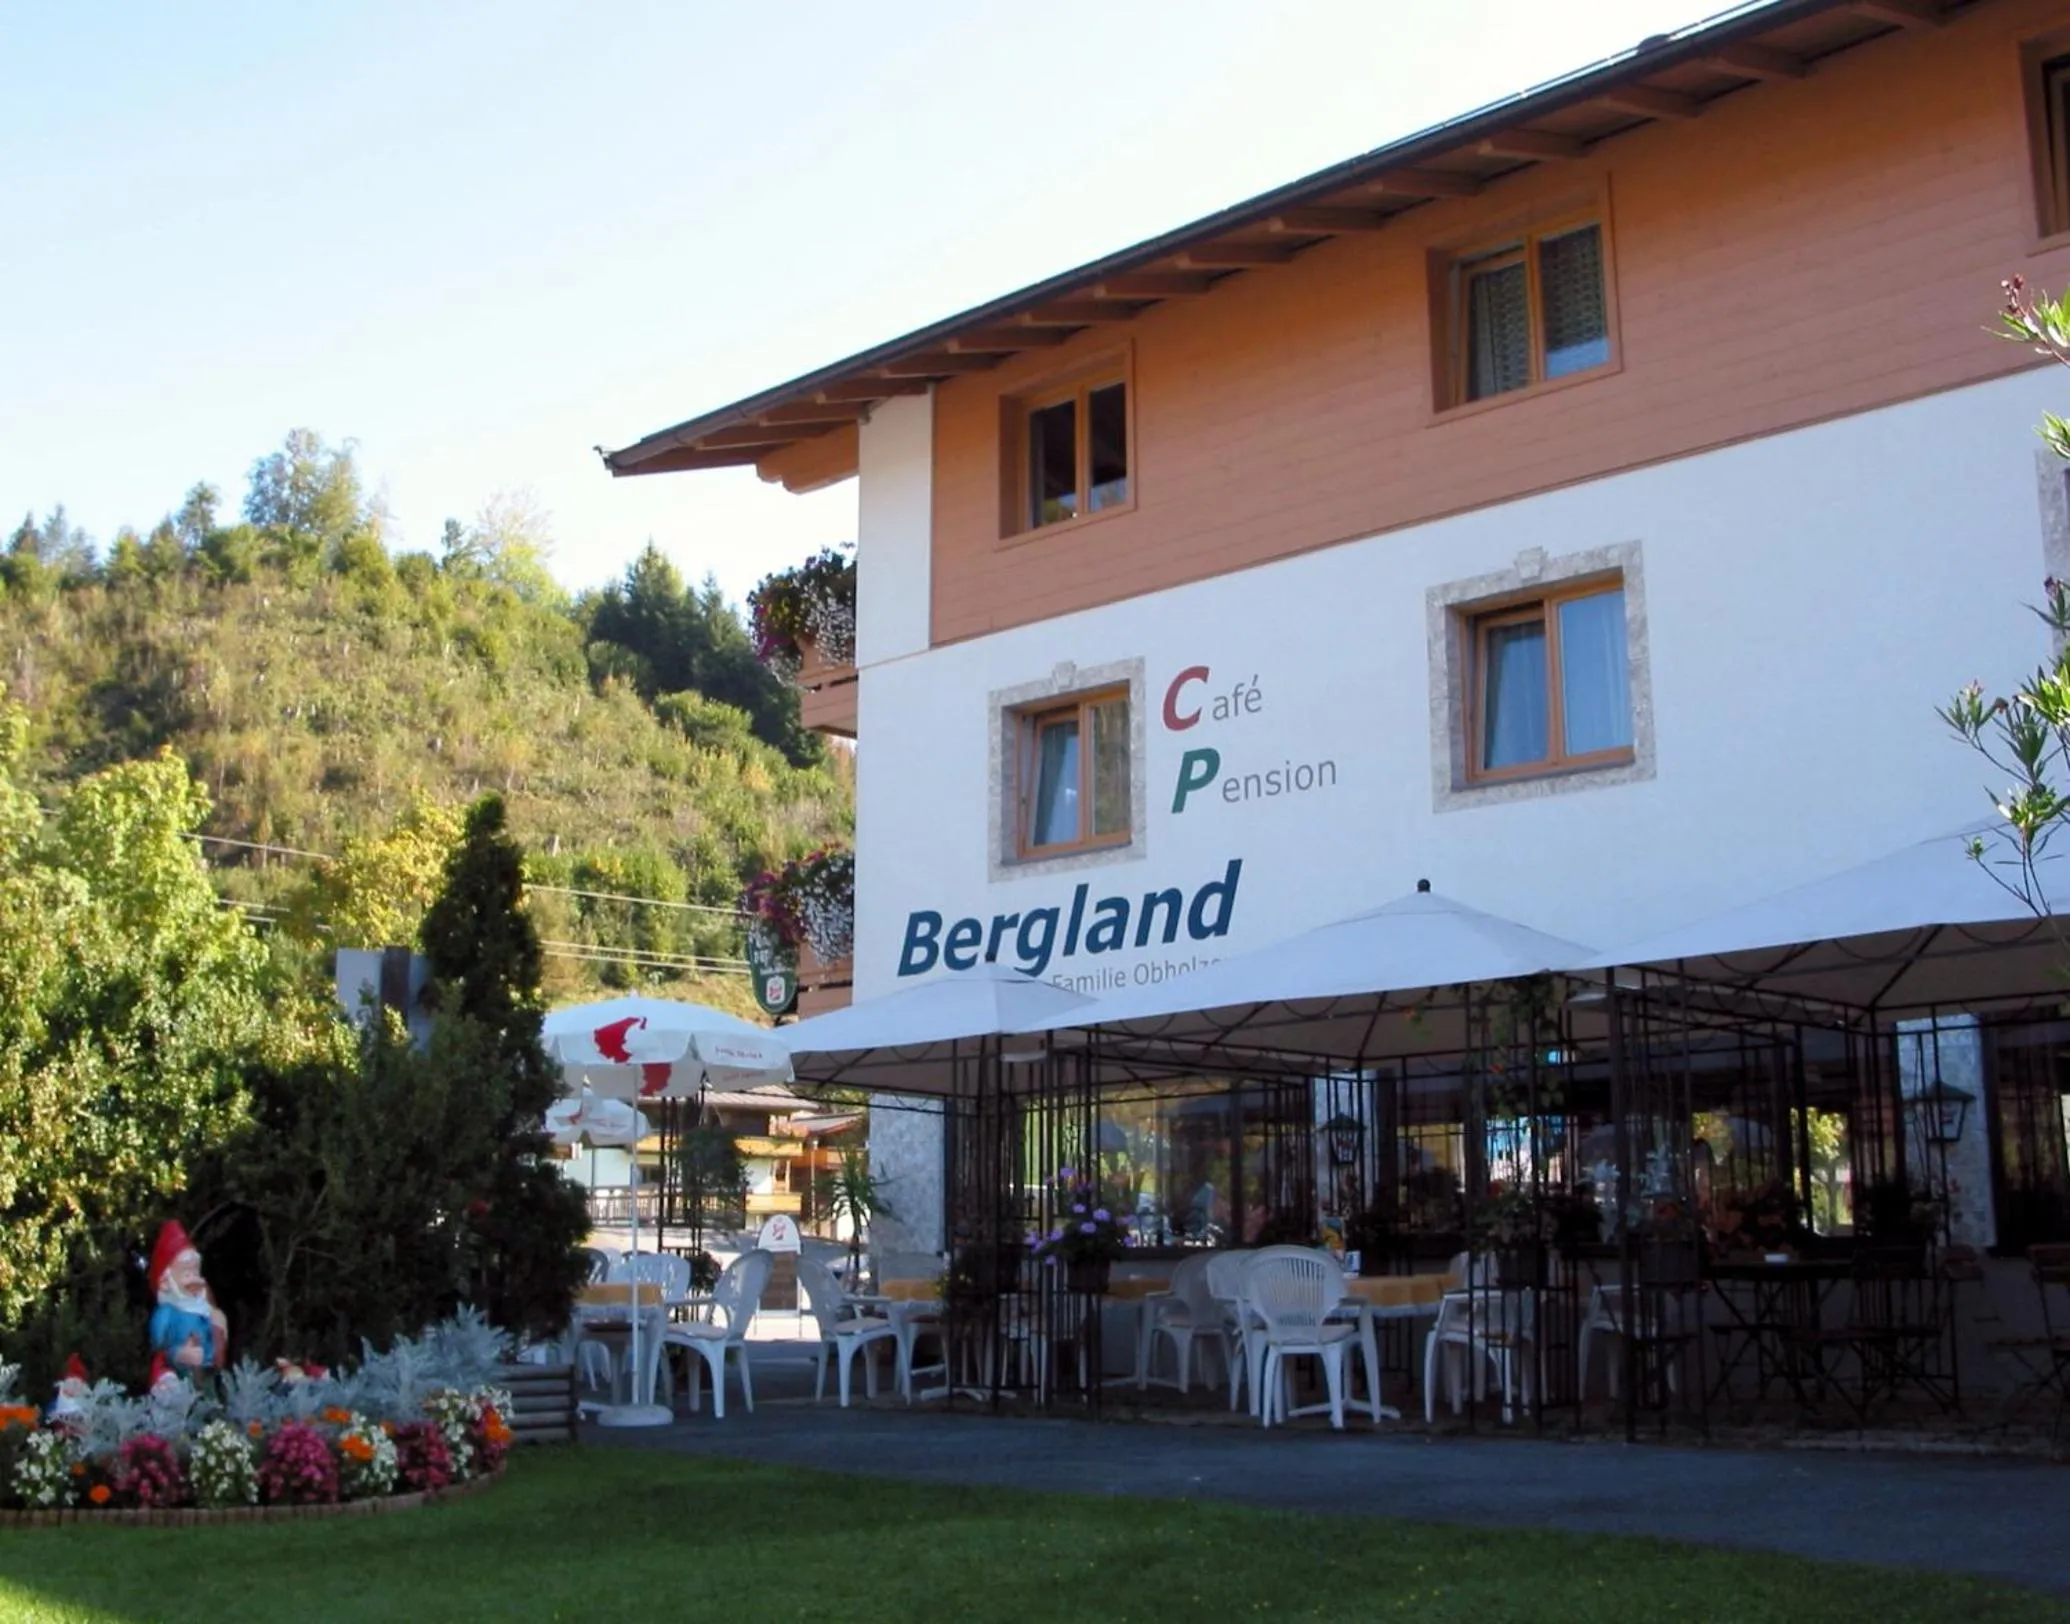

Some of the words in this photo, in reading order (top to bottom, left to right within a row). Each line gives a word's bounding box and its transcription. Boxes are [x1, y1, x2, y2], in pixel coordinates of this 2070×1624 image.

[1162, 666, 1263, 731] Café
[1171, 747, 1337, 814] Pension
[897, 858, 1243, 979] Bergland
[1052, 967, 1126, 994] Familie
